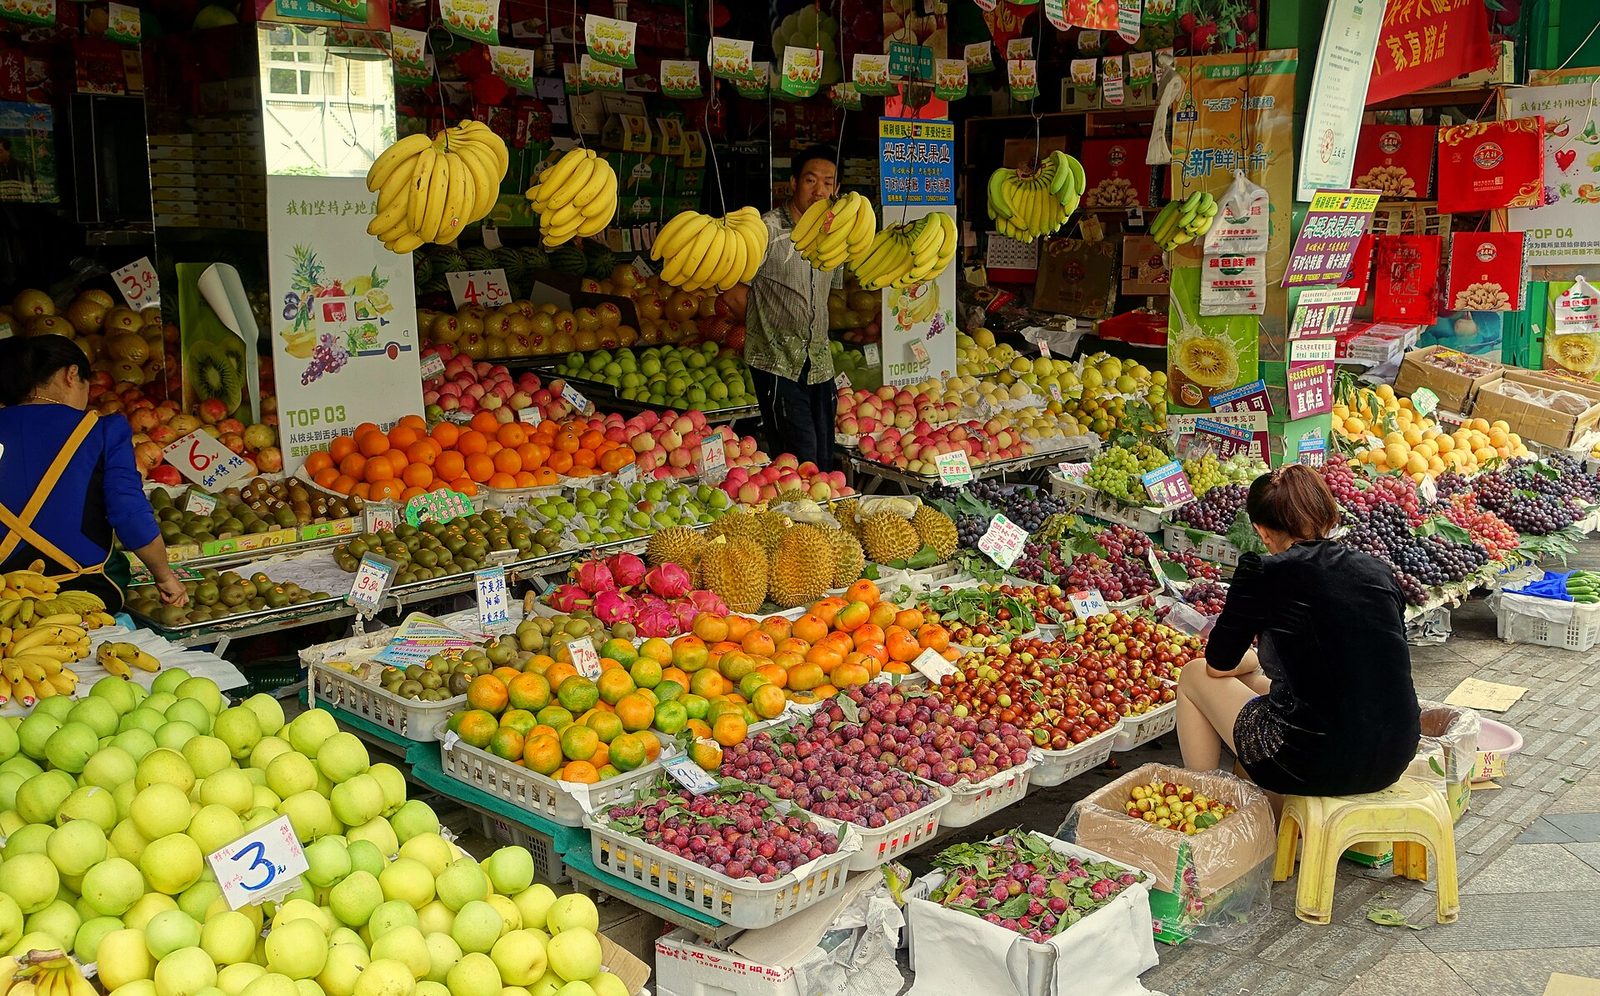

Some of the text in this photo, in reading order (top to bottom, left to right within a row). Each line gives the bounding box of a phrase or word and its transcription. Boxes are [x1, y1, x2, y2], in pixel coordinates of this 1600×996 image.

[1520, 97, 1600, 113] 我们坚持用心服
[924, 126, 952, 140] 享受好生活
[1184, 143, 1268, 178] 新鲜上市
[1302, 215, 1366, 240] 兴旺农民果业
[1556, 228, 1573, 239] 04
[1209, 258, 1256, 268] 绿色鲜果
[1326, 252, 1353, 270] 刷卡消费
[888, 361, 919, 376] TOP 02
[1297, 388, 1325, 414] 直供点
[286, 405, 346, 427] TOP 03
[1178, 415, 1256, 425] 农大葡萄博览园
[289, 430, 340, 444] 从枝头到舌头
[290, 442, 331, 457] 坚持品质
